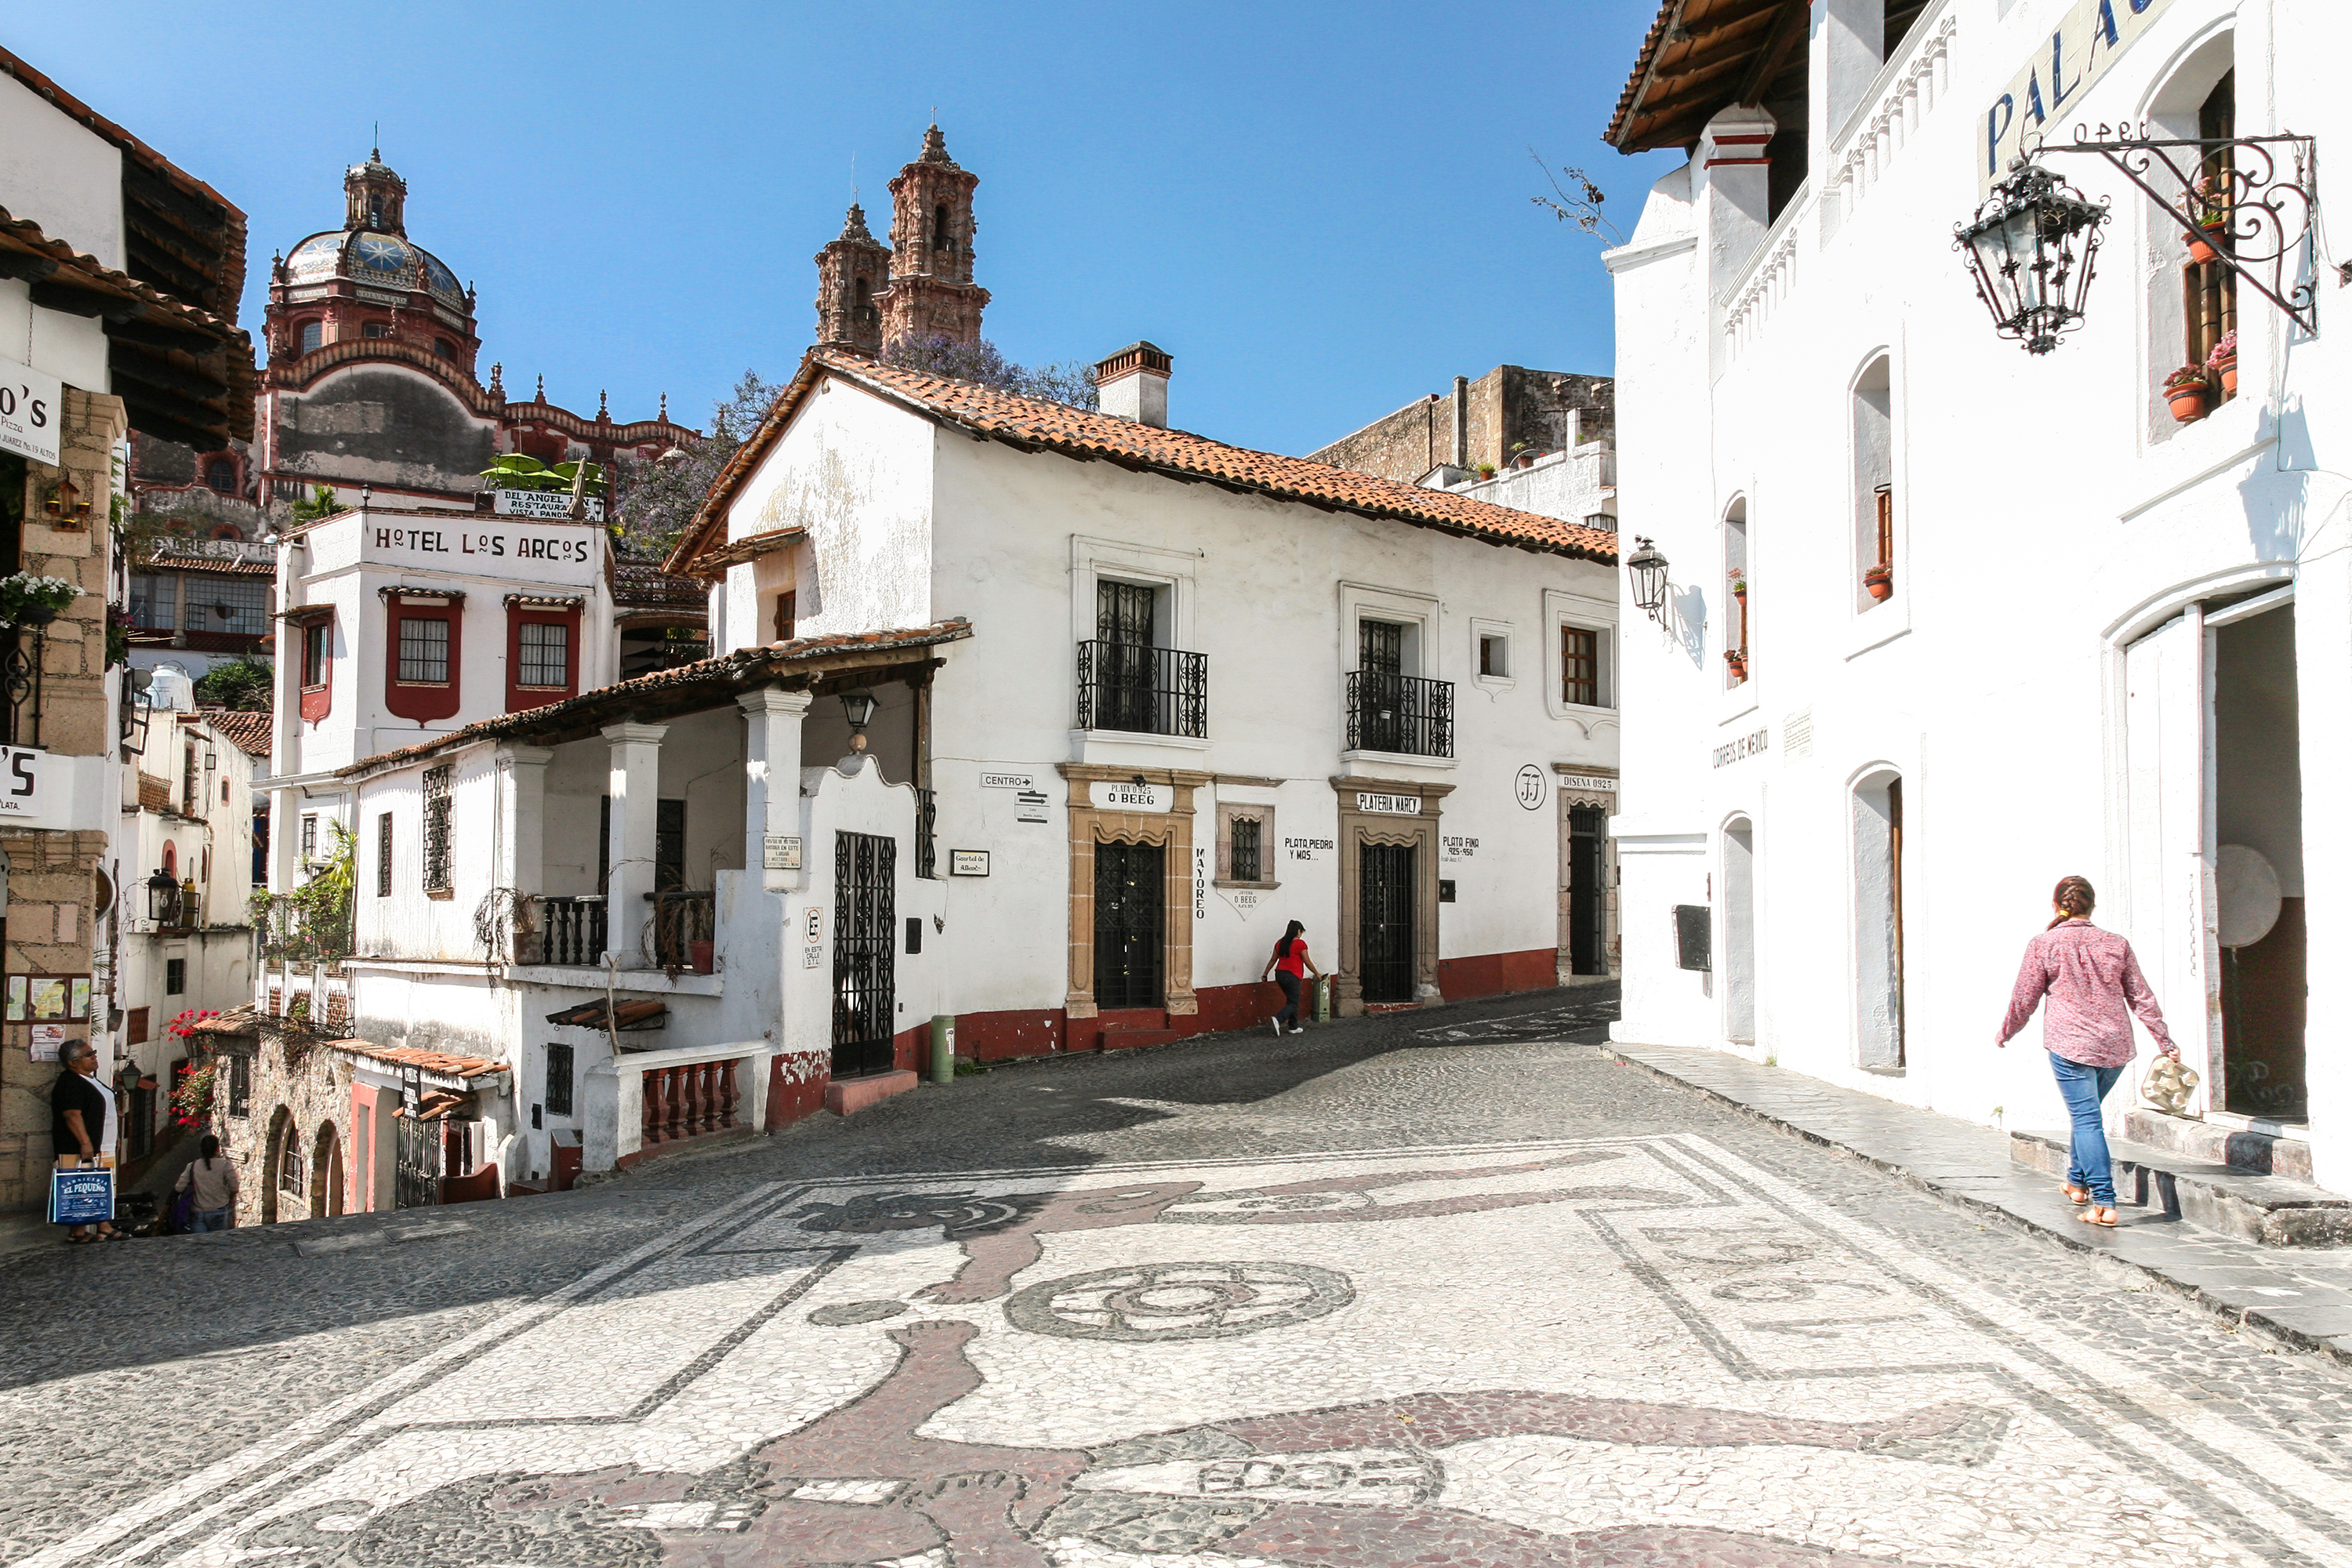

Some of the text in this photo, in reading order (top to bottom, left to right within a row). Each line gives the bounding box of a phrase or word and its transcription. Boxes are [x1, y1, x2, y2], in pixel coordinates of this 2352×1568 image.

[1988, 0, 2154, 180] PALA
[2, 416, 24, 433] Pizza
[2, 434, 22, 448] JUAREZ
[40, 447, 56, 460] ALTOS
[505, 491, 522, 500] DEL
[569, 496, 590, 506] IN
[509, 508, 535, 517] VISTA
[376, 528, 587, 563] HOTEL LOS ARCOS
[1713, 741, 1736, 769] CORREOS
[1738, 737, 1745, 760] DE
[1748, 729, 1768, 757] MEXICO
[985, 776, 1022, 786] CENTRO
[1592, 779, 1612, 789] 0925
[1111, 784, 1131, 793] PLATA
[1121, 793, 1155, 804] BEEG
[1360, 794, 1417, 813] PLATERIA NARCY
[1443, 836, 1479, 848] PLATA FINA
[1290, 850, 1294, 860] Y
[1196, 848, 1205, 919] MAYOREO
[74, 1182, 106, 1194] PEQUEÑO
